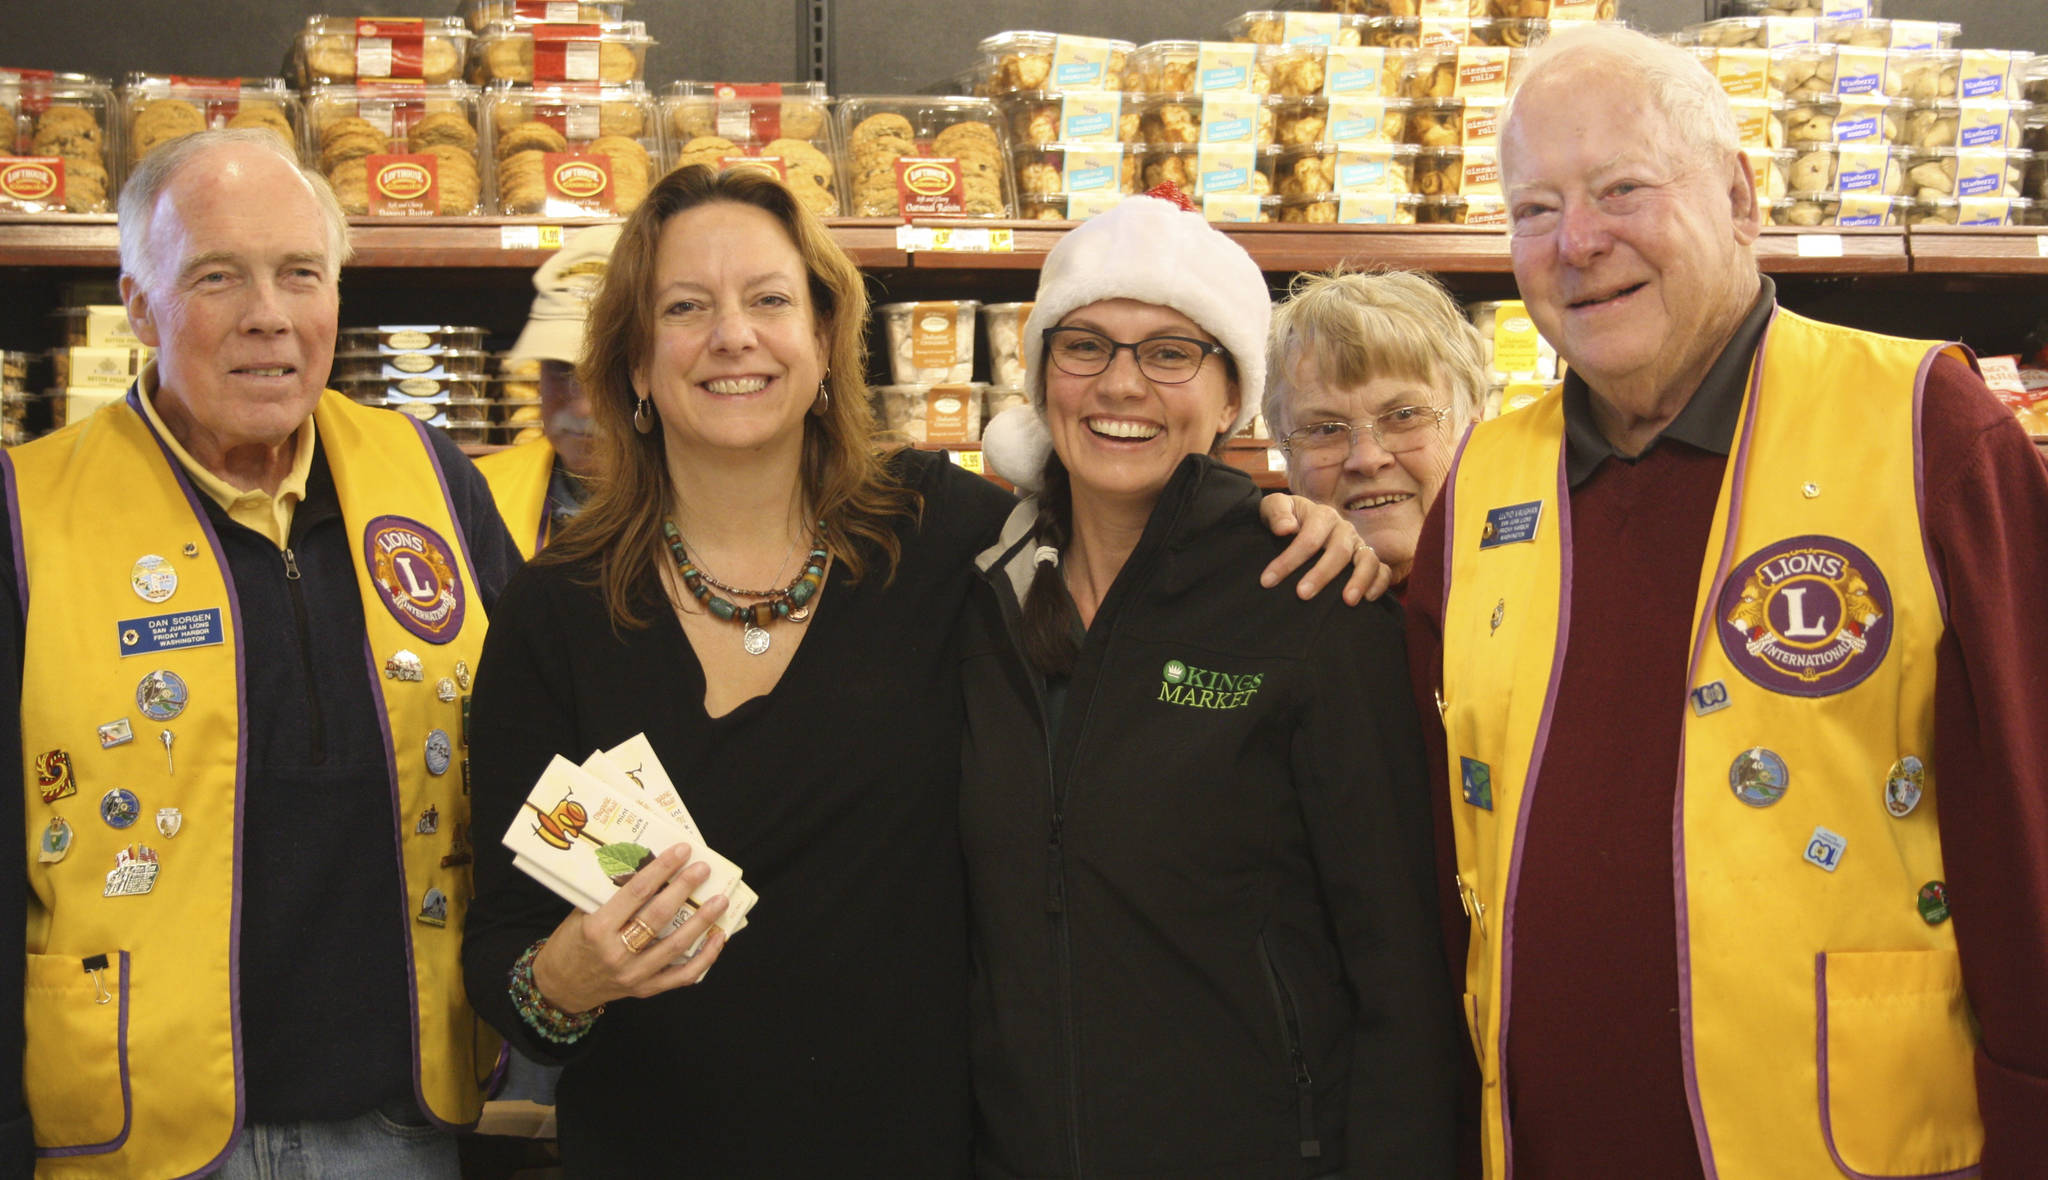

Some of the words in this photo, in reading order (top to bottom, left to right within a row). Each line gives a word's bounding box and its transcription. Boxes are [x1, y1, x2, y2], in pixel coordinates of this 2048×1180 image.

[1461, 64, 1503, 76] cinnamon
[1470, 73, 1495, 82] rolls
[379, 532, 424, 553] LIONS
[395, 557, 435, 597] L
[1763, 555, 1841, 582] LIONS
[402, 596, 452, 621] INTERNATIONAL
[1781, 588, 1827, 636] L
[148, 619, 169, 629] DAN
[172, 613, 211, 625] SORGEN
[153, 633, 179, 641] FRIDAY
[181, 628, 210, 637] HARBOR
[160, 635, 205, 647] WASHINGTON
[1763, 639, 1851, 667] INTERNATIONAL
[1184, 665, 1265, 691] KINGS
[1157, 681, 1258, 709] MARKET
[1751, 761, 1765, 770] 40
[615, 807, 628, 825] mint
[630, 817, 643, 833] dark
